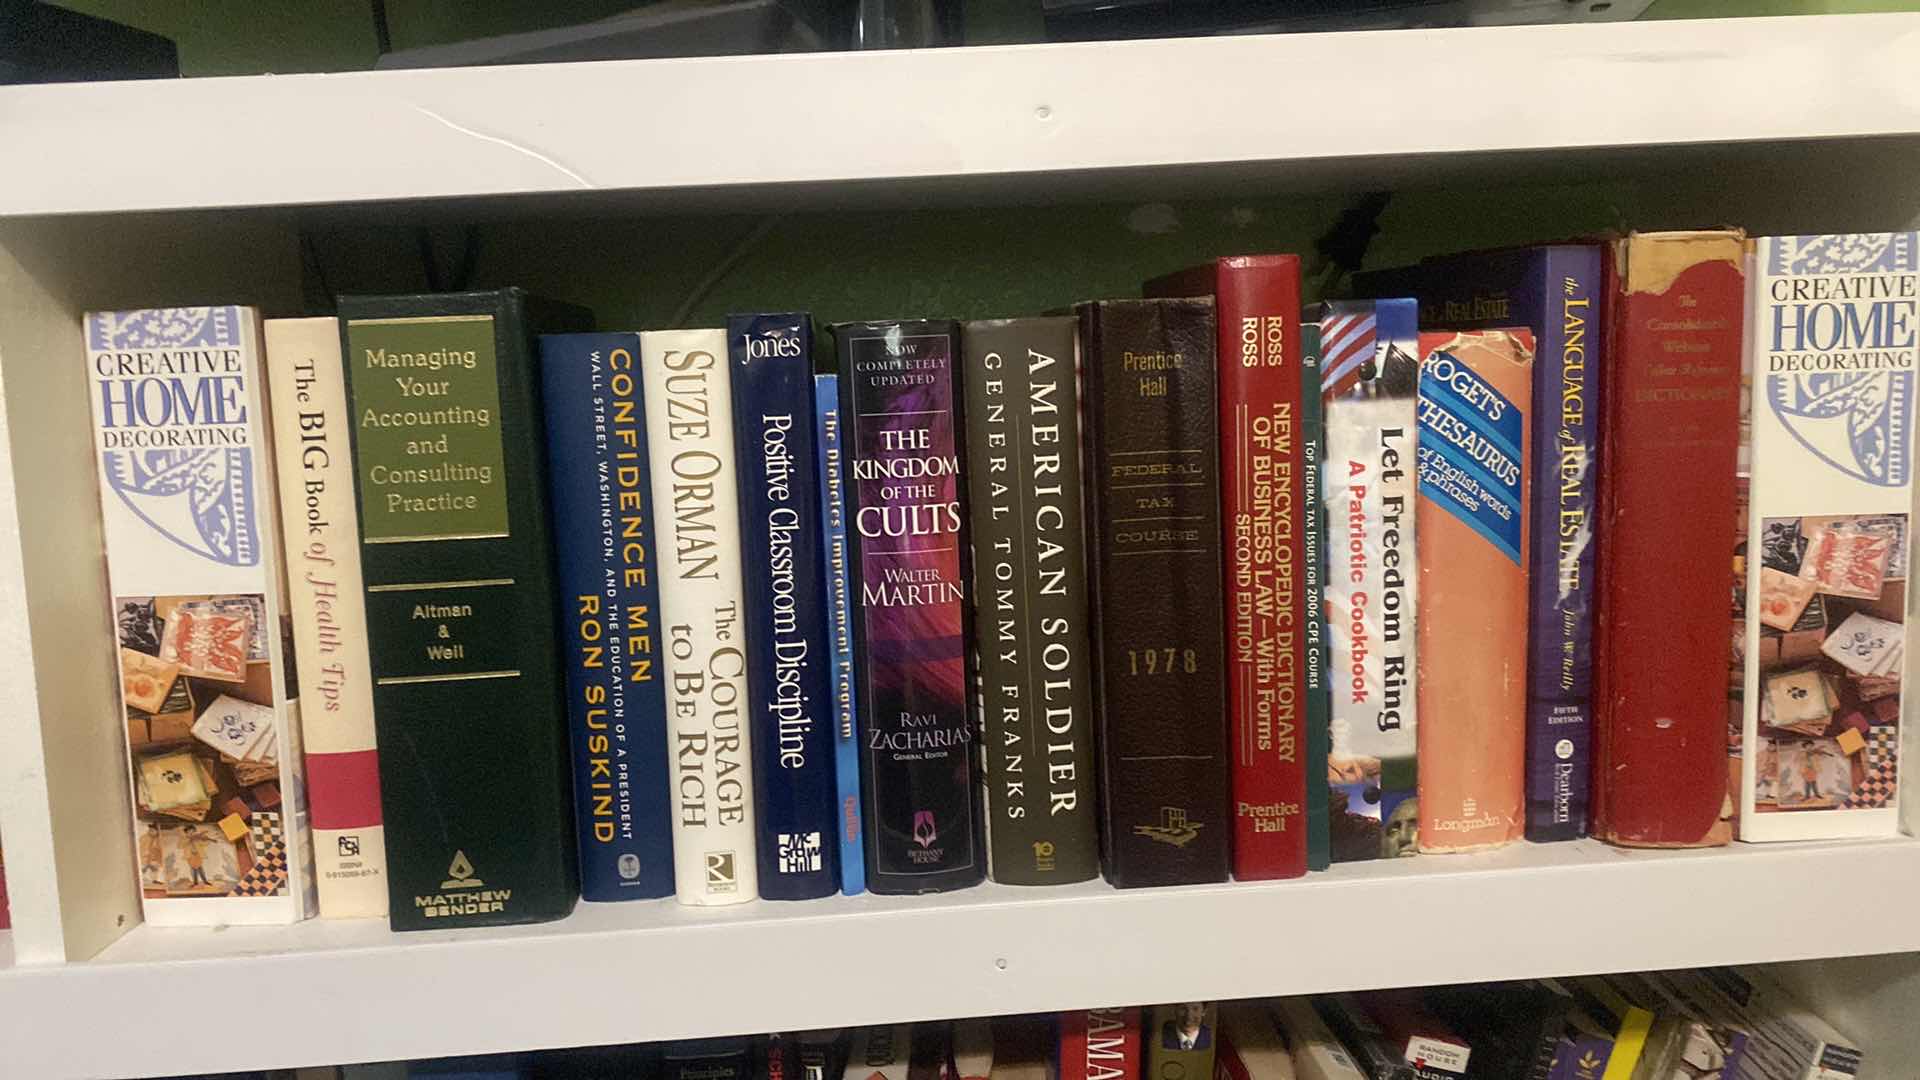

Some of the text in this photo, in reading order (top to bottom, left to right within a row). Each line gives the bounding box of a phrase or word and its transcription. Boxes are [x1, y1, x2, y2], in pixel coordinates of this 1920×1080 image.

[1563, 276, 1581, 297] the
[1770, 274, 1917, 302] CREATIVE
[1769, 300, 1916, 352] HOME
[741, 331, 801, 365] Jones
[886, 343, 918, 358] NOW
[1241, 316, 1259, 368] ROSS
[1267, 315, 1283, 368] ROSS
[96, 349, 241, 378] CREATIVE
[365, 346, 477, 371] Managing
[855, 357, 947, 374] COMPLETELY
[1123, 350, 1183, 372] Prentice
[1562, 297, 1590, 428] LANGUAGE
[1769, 351, 1913, 372] DECORATING
[396, 376, 451, 398] Your
[869, 374, 936, 388] UPDATED
[1139, 376, 1168, 397] Hall
[98, 374, 248, 428] HOME
[361, 406, 490, 429] Accounting
[1252, 415, 1271, 449] OF
[104, 426, 247, 449] DECORATING
[406, 433, 449, 456] and
[880, 428, 931, 451] THE
[1418, 396, 1521, 487] THESAURUS
[1558, 424, 1577, 444] of
[369, 462, 493, 486] Consulting
[664, 350, 722, 580] SUZE ORMAN
[852, 455, 960, 481] KINGDOM
[1027, 347, 1068, 597] AMERICAN
[1111, 462, 1202, 478] FEDERAL
[1559, 442, 1587, 506] REAL
[880, 483, 937, 501] OF THE
[1418, 446, 1512, 521] of English words
[1418, 462, 1480, 513] & phrases
[386, 493, 479, 514] Practice
[608, 347, 653, 683] CONFIDENCE MEN
[1135, 496, 1175, 510] TAX
[1253, 455, 1273, 565] BUSINESS
[856, 501, 961, 539] CULTS
[295, 358, 346, 712] The BIG Book of Health Tips
[1115, 529, 1200, 545] COURSE
[824, 409, 852, 740] The Diabetes Improvement Program
[884, 567, 942, 584] WALTER
[984, 351, 1026, 820] GENERAL TOMMY FRANKS
[1235, 513, 1253, 662] SECOND EDITION
[1273, 402, 1297, 763] NEW ENCYCLOPEDIC DICTIONARY
[1348, 460, 1369, 704] A Patriotic Cookbook
[1376, 427, 1407, 733] Let Freedom Ring
[589, 351, 633, 841] WALL STREET, WASHINGTON, AND THE EDUCATION OF A PRESIDENT
[762, 412, 813, 770] Positive Classroom Discipline
[861, 578, 965, 607] MARTIN
[1307, 588, 1319, 618] 2006
[412, 603, 473, 620] Altman
[1562, 607, 1576, 636] John
[438, 625, 451, 639] &
[1307, 620, 1319, 645] CPE
[427, 644, 465, 661] Weil
[1127, 647, 1198, 676] 1978
[1307, 647, 1320, 689] COURSE
[1560, 657, 1575, 691] Reilly
[578, 595, 616, 843] RON SUSKIND
[671, 622, 709, 830] to BE RICH
[708, 600, 747, 828] The COURAGE
[900, 712, 937, 729] RAVI
[1041, 616, 1078, 818] SOLDIER
[1256, 690, 1276, 751] Forms
[868, 723, 973, 751] ZACHARIAS
[1559, 762, 1575, 823] Dearborn
[1238, 801, 1299, 818] Prentice
[1254, 817, 1286, 834] Hall
[414, 889, 512, 908] MATTHEW
[424, 900, 504, 918] BENDER
[1087, 1006, 1126, 1080] AMA
